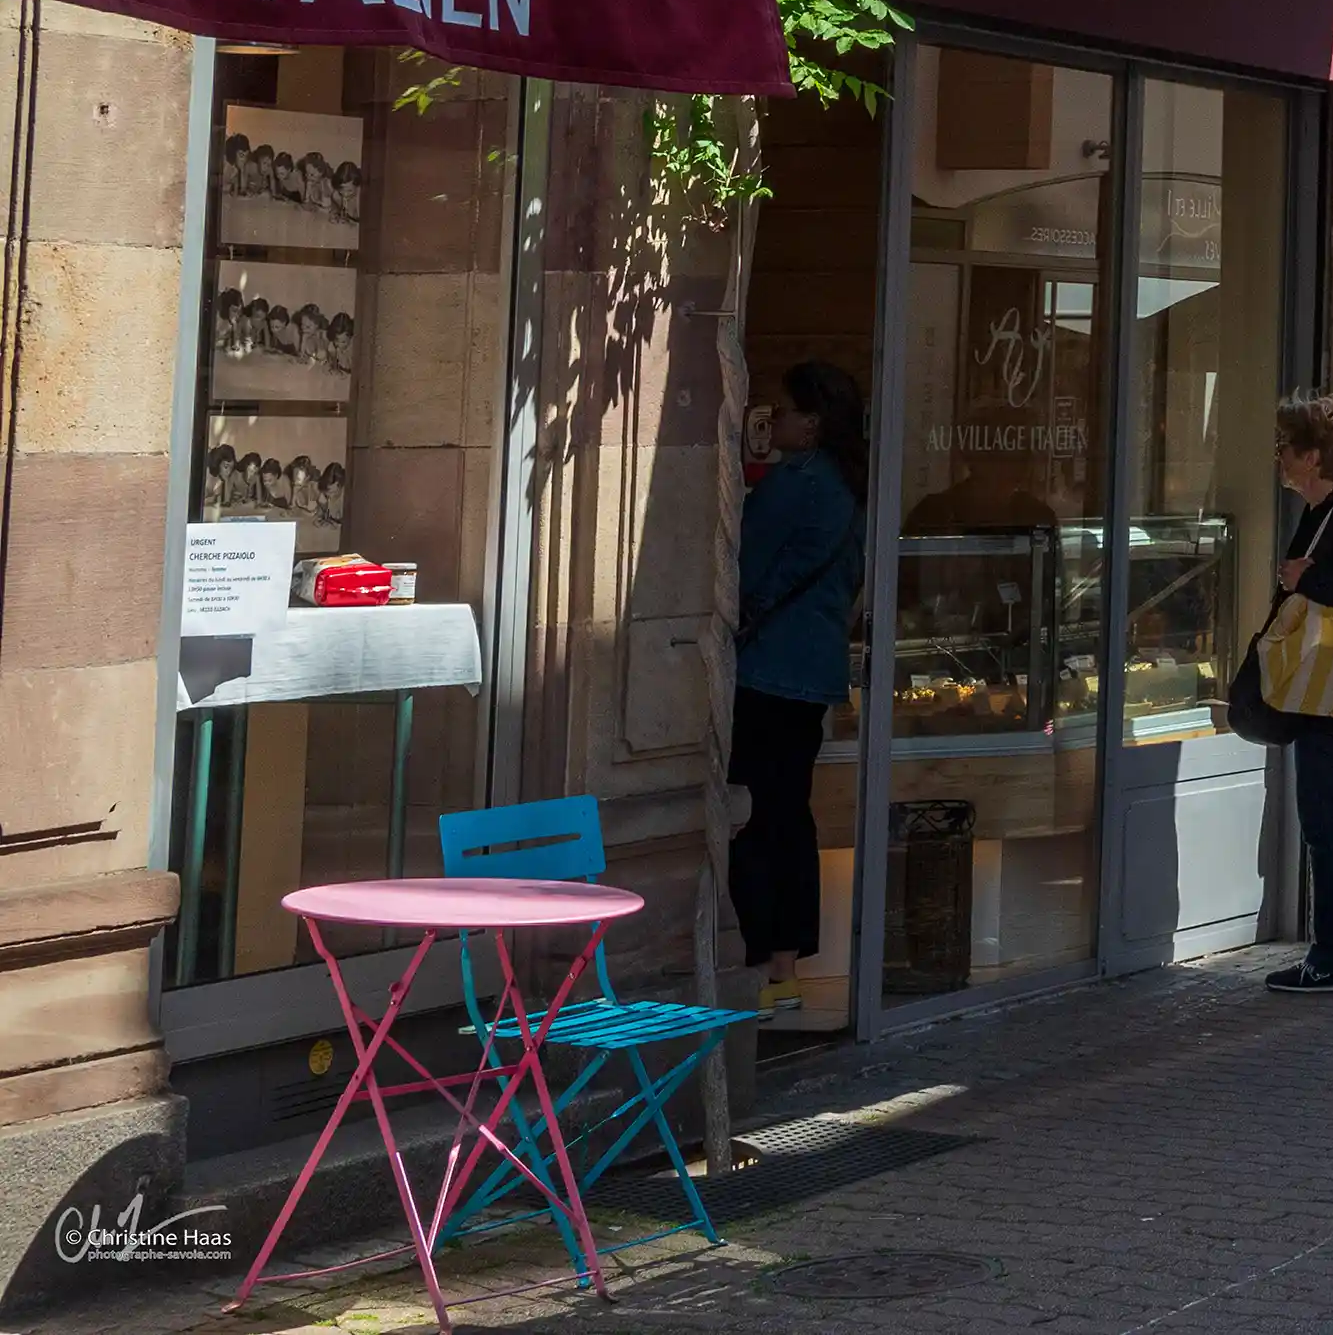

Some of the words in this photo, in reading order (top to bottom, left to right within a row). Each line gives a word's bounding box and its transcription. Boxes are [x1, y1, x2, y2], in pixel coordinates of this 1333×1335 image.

[926, 425, 954, 451] AU
[957, 424, 1026, 451] VILLAGE
[190, 538, 216, 546] URGENT
[189, 552, 221, 561] CHERCHE
[222, 551, 256, 560] PIZZAIOLO
